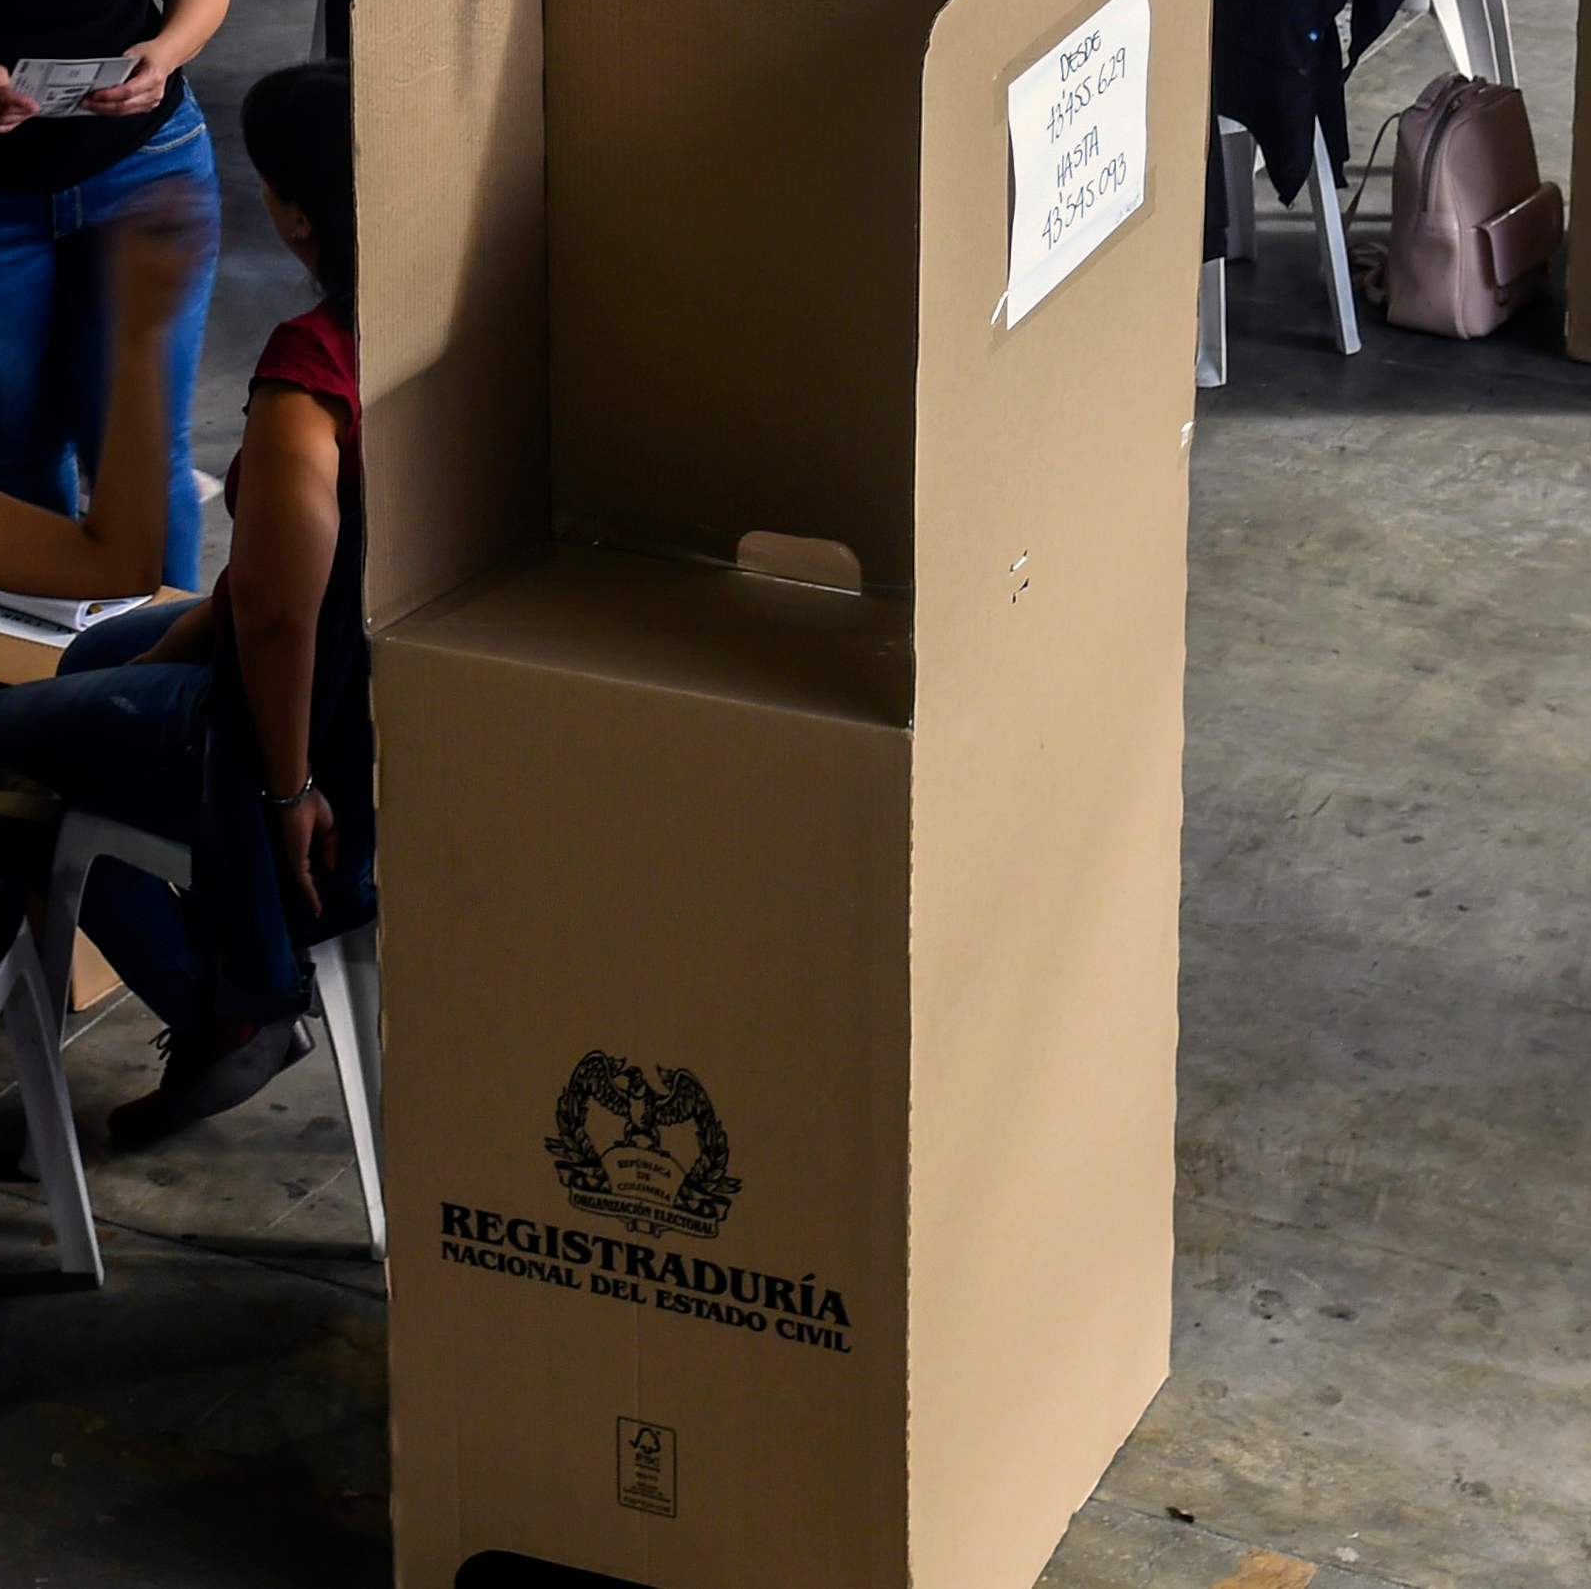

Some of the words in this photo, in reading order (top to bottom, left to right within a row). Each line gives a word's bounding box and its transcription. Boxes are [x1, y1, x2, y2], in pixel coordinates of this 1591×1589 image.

[1059, 29, 1102, 82] DESDE
[1057, 125, 1099, 188] HASTA
[573, 1193, 652, 1218] ORGANIZACIÓN
[654, 1208, 715, 1235] ELECTORAL
[439, 1202, 851, 1328] REGISTRADURÍA
[441, 1242, 582, 1290] NACIONAL
[590, 1275, 647, 1304] DEL
[656, 1291, 767, 1332] ESTADO
[775, 1319, 852, 1354] CIVIL
